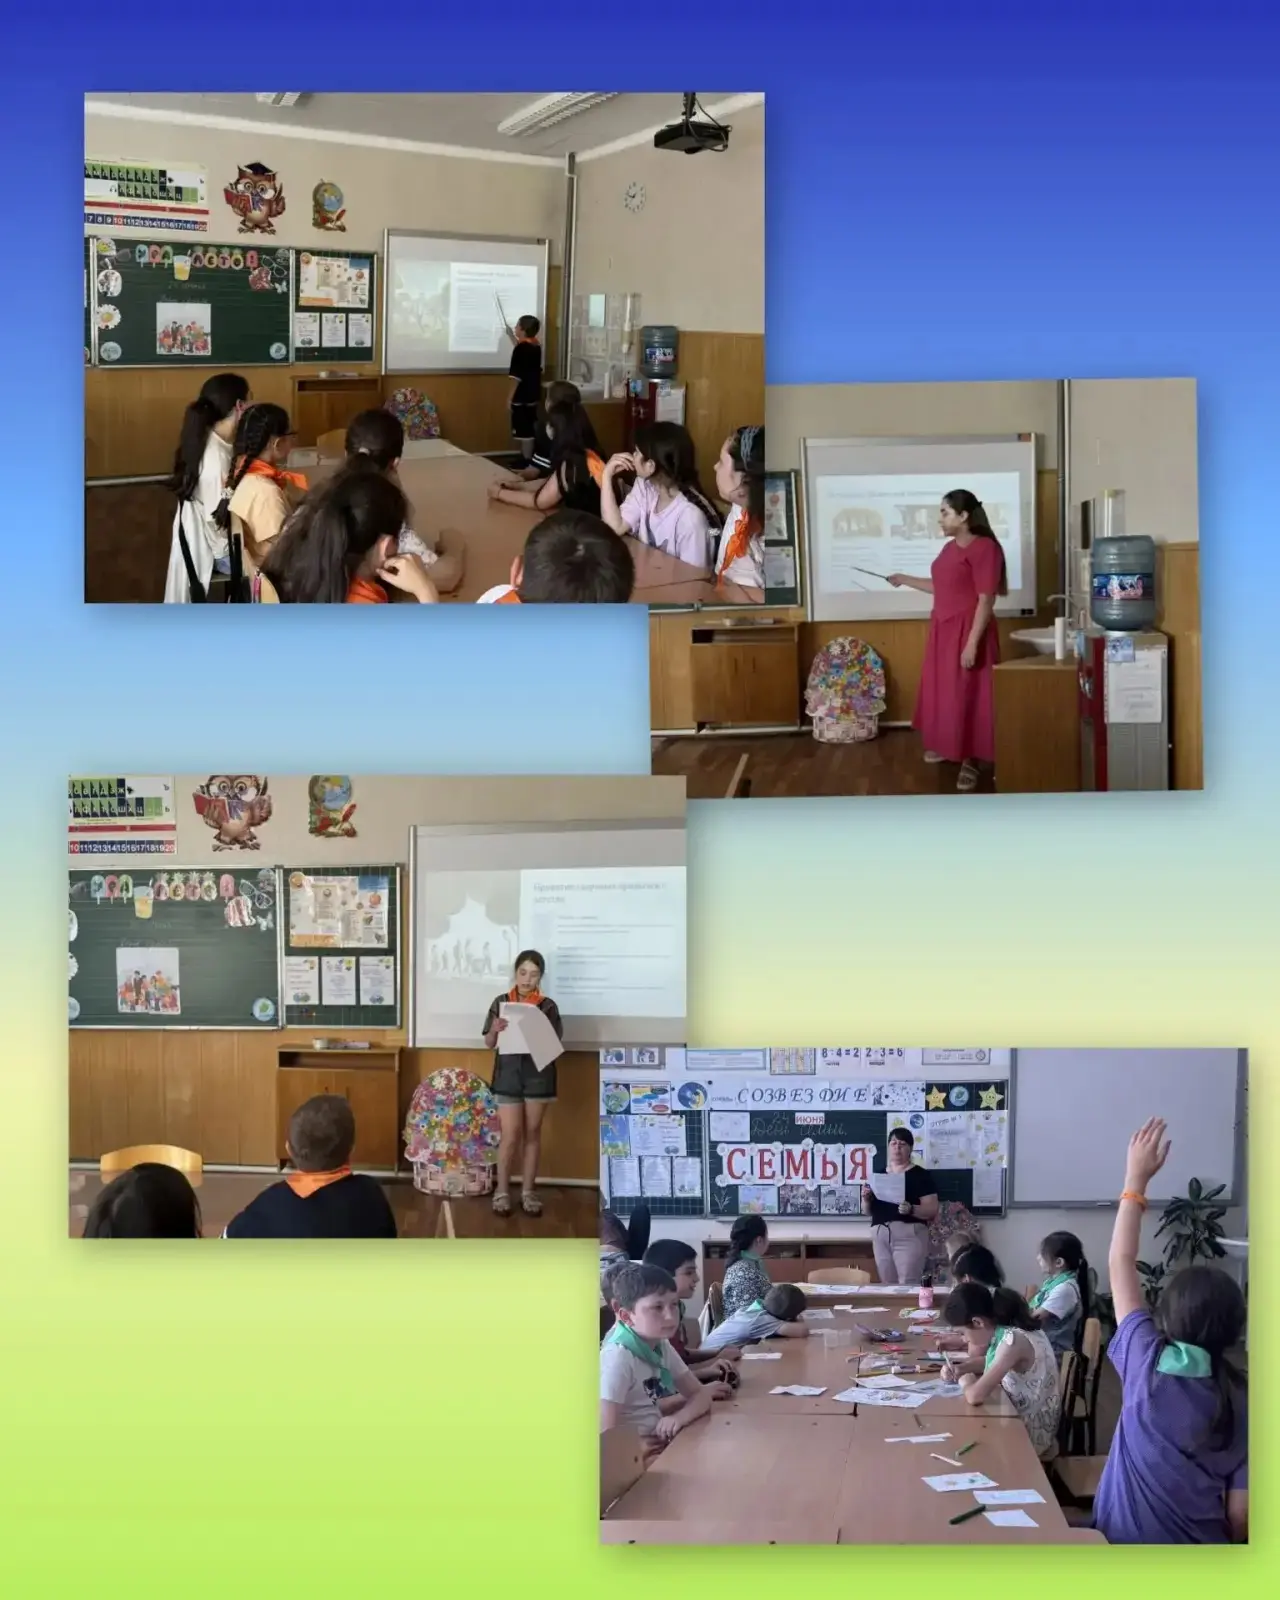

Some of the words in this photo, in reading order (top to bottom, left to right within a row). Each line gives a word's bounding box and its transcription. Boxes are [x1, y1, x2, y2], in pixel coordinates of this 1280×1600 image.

[822, 1048, 828, 1058] 8
[836, 1048, 842, 1057] 4
[853, 1048, 860, 1058] 2
[866, 1048, 872, 1058] 2
[880, 1048, 886, 1058] 3
[897, 1048, 903, 1058] 6
[737, 1087, 868, 1104] СОЗВЕЗДИЕ
[796, 1115, 825, 1124] ИЮНЯ
[727, 1147, 868, 1181] СЕМЬЯ
